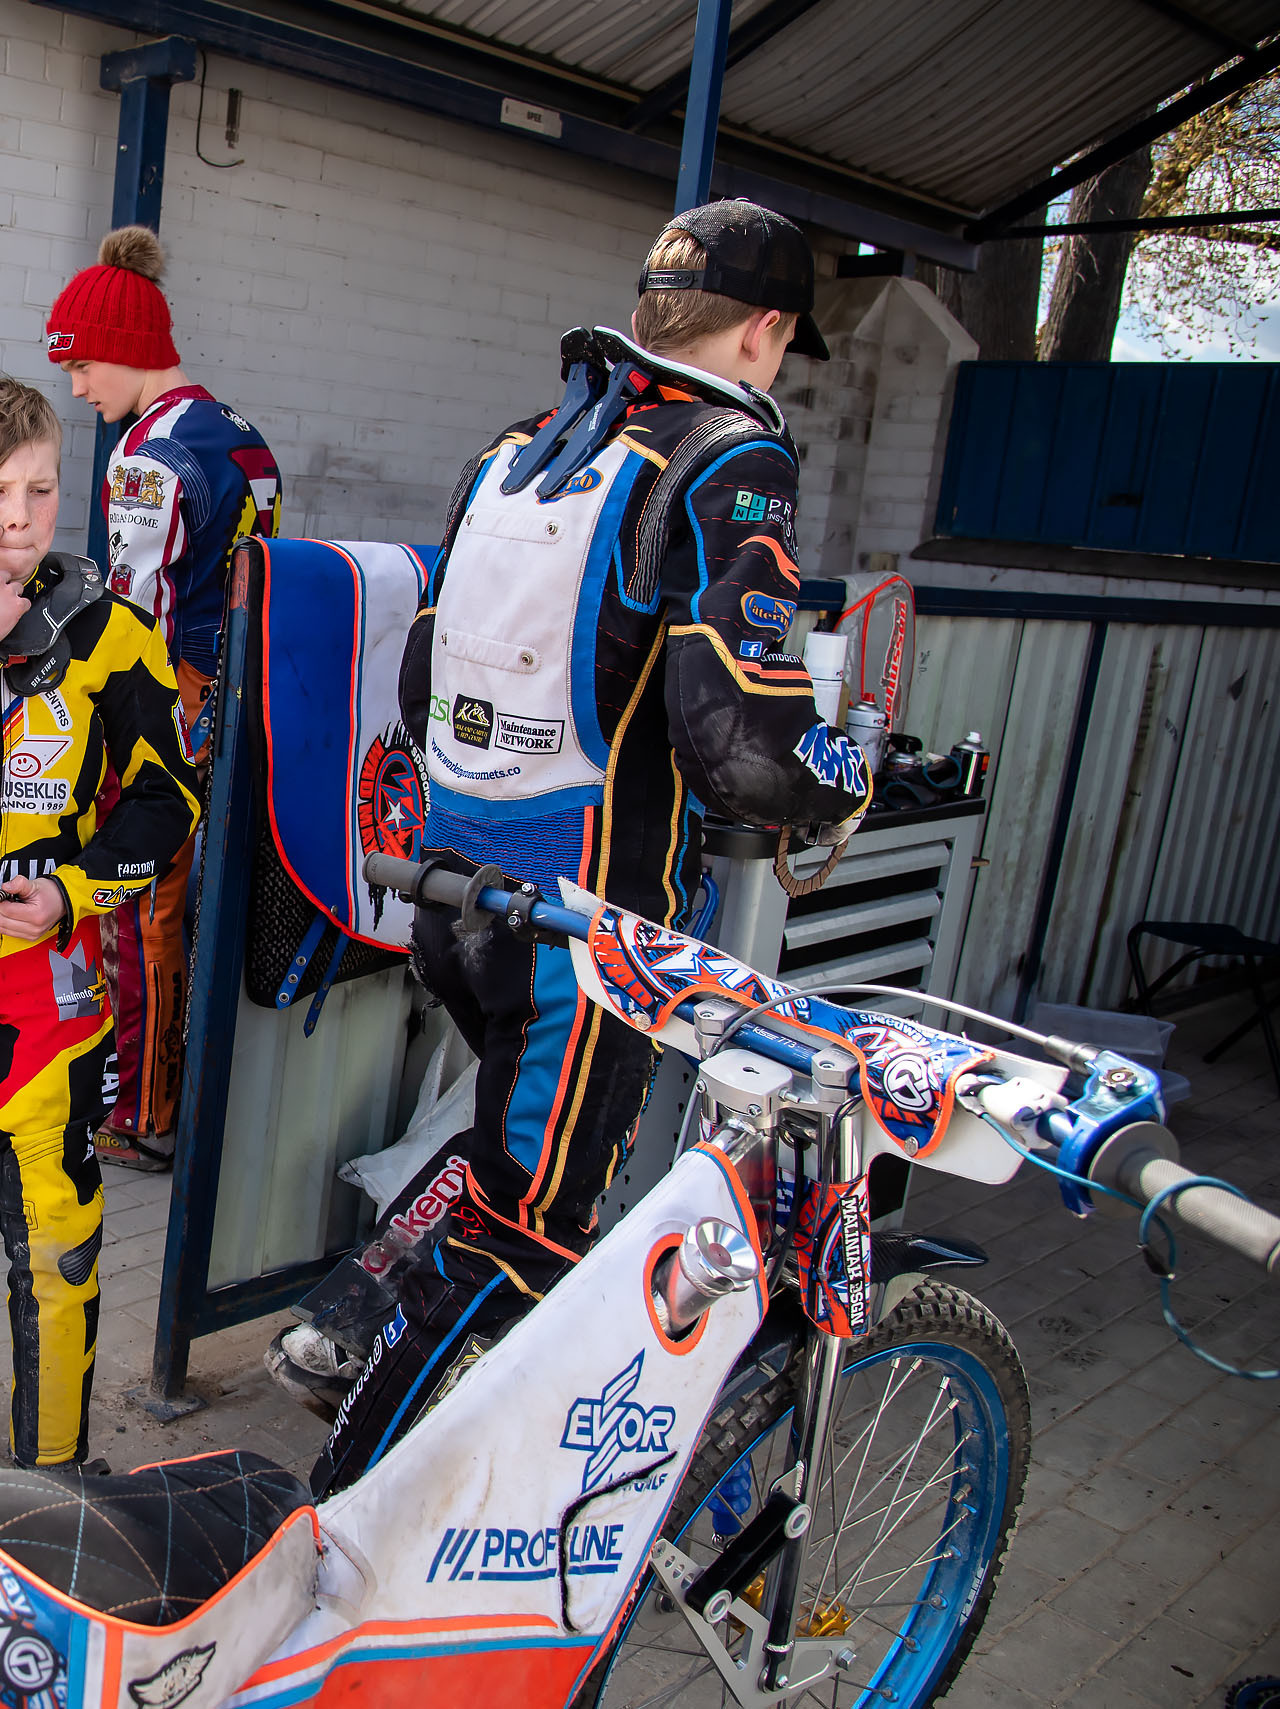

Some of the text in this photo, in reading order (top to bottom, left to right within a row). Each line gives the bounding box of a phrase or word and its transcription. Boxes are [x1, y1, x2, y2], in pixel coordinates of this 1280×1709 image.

[128, 514, 159, 529] DOME
[45, 689, 69, 727] ENTRS
[500, 719, 557, 737] Maintenance
[500, 732, 555, 749] NETWORK
[1, 801, 64, 811] ANNO 1989
[117, 859, 155, 878] FACTORY
[56, 989, 93, 1003] minimoto
[859, 1012, 932, 1048] speedway
[559, 1397, 677, 1453] EVOR
